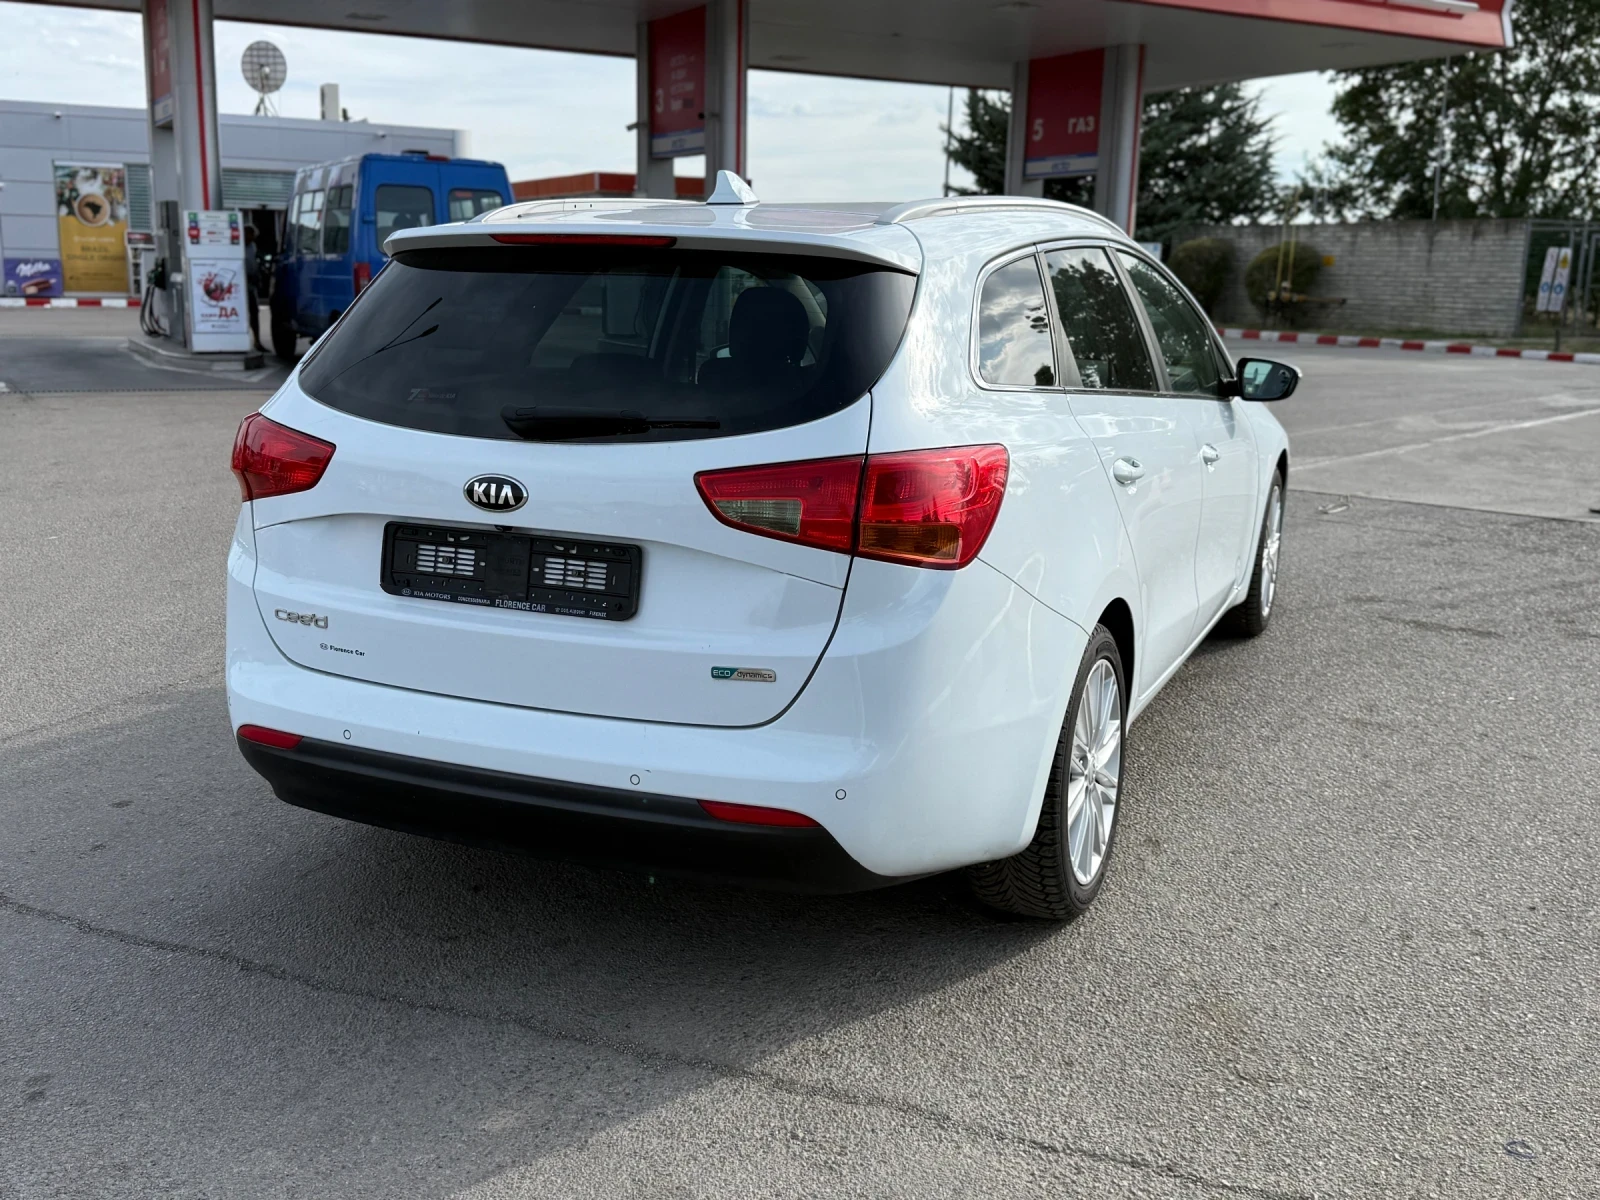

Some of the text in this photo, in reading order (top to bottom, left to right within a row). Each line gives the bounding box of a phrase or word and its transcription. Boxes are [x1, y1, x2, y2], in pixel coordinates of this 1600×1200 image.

[1031, 118, 1045, 142] 5
[1067, 115, 1096, 134] ГАЗ
[15, 261, 52, 277] Milka
[218, 306, 239, 319] ДА
[473, 481, 516, 506] KIA
[424, 592, 451, 600] MOTORS
[495, 599, 546, 612] FLORENCE CAR
[329, 645, 354, 654] Florence
[354, 649, 365, 657] Car
[712, 669, 773, 679] ECO dynamics
